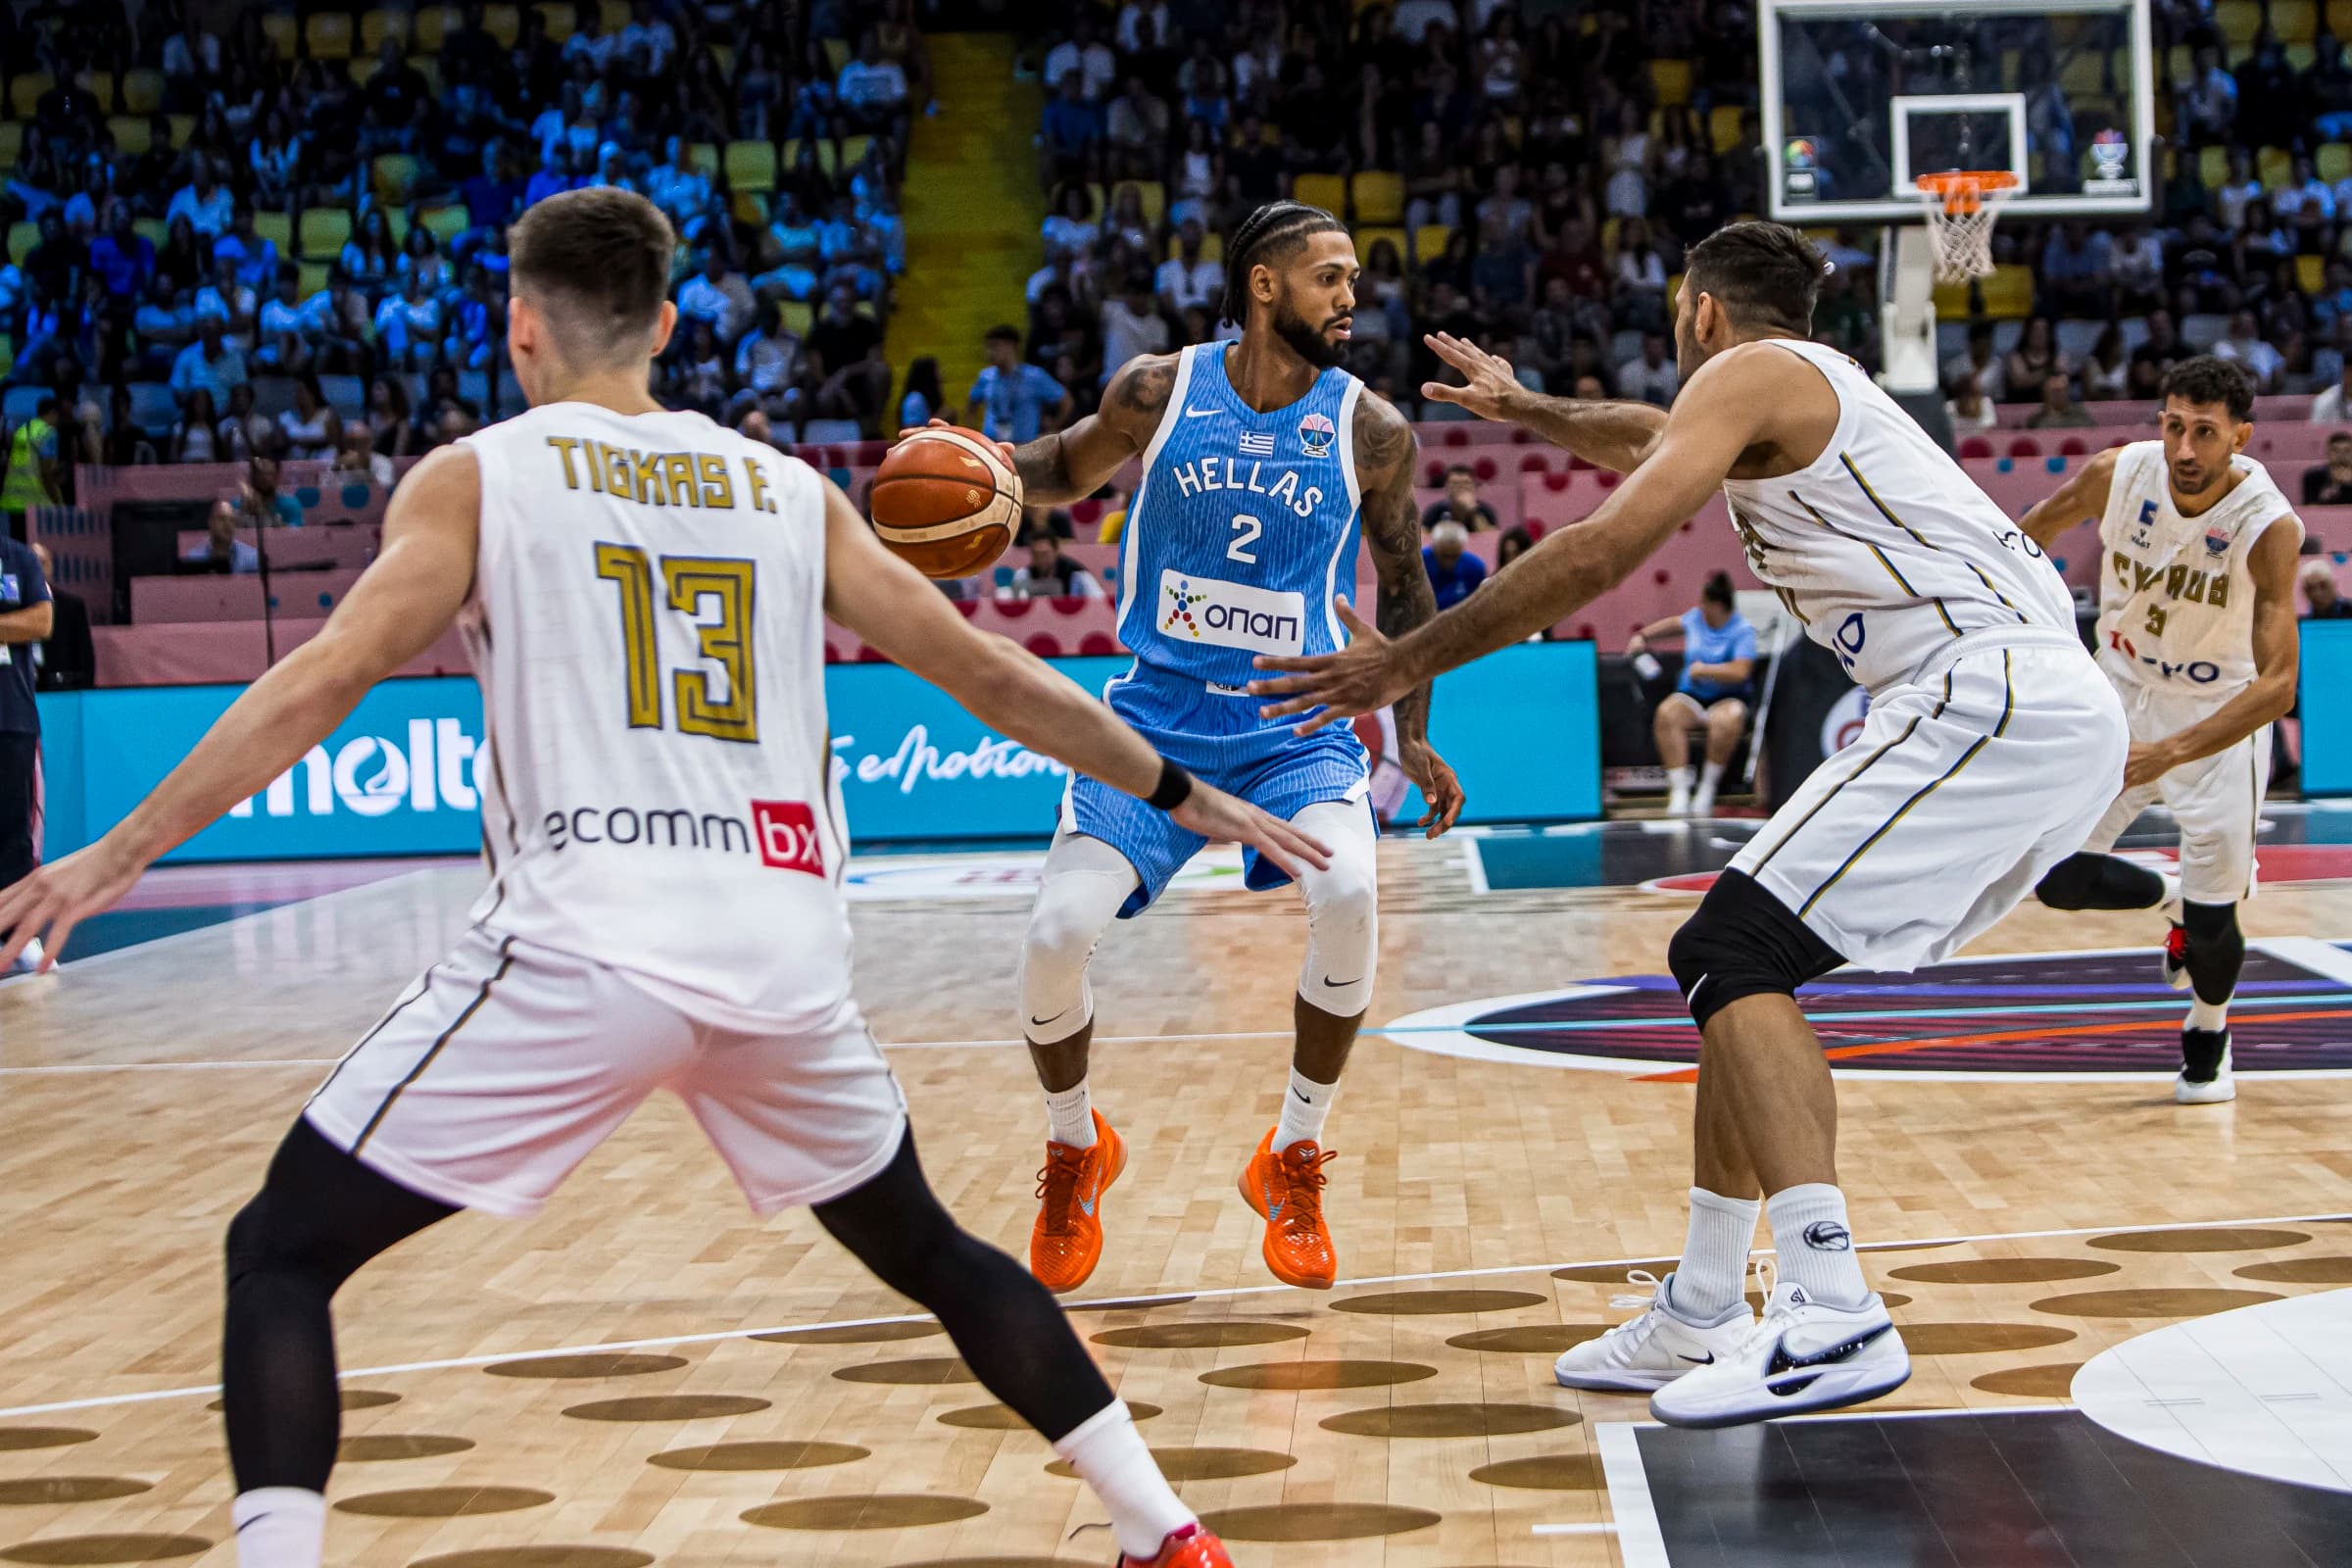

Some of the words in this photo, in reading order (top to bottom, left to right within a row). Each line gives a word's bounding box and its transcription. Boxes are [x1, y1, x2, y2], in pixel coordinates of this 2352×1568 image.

[546, 435, 733, 509] TIGKAS
[1173, 457, 1323, 517] HELLAS
[1226, 514, 1262, 564] 2
[594, 541, 760, 744] 13
[2144, 604, 2167, 637] 3
[228, 717, 486, 817] molt
[544, 807, 823, 867] ecommbx
